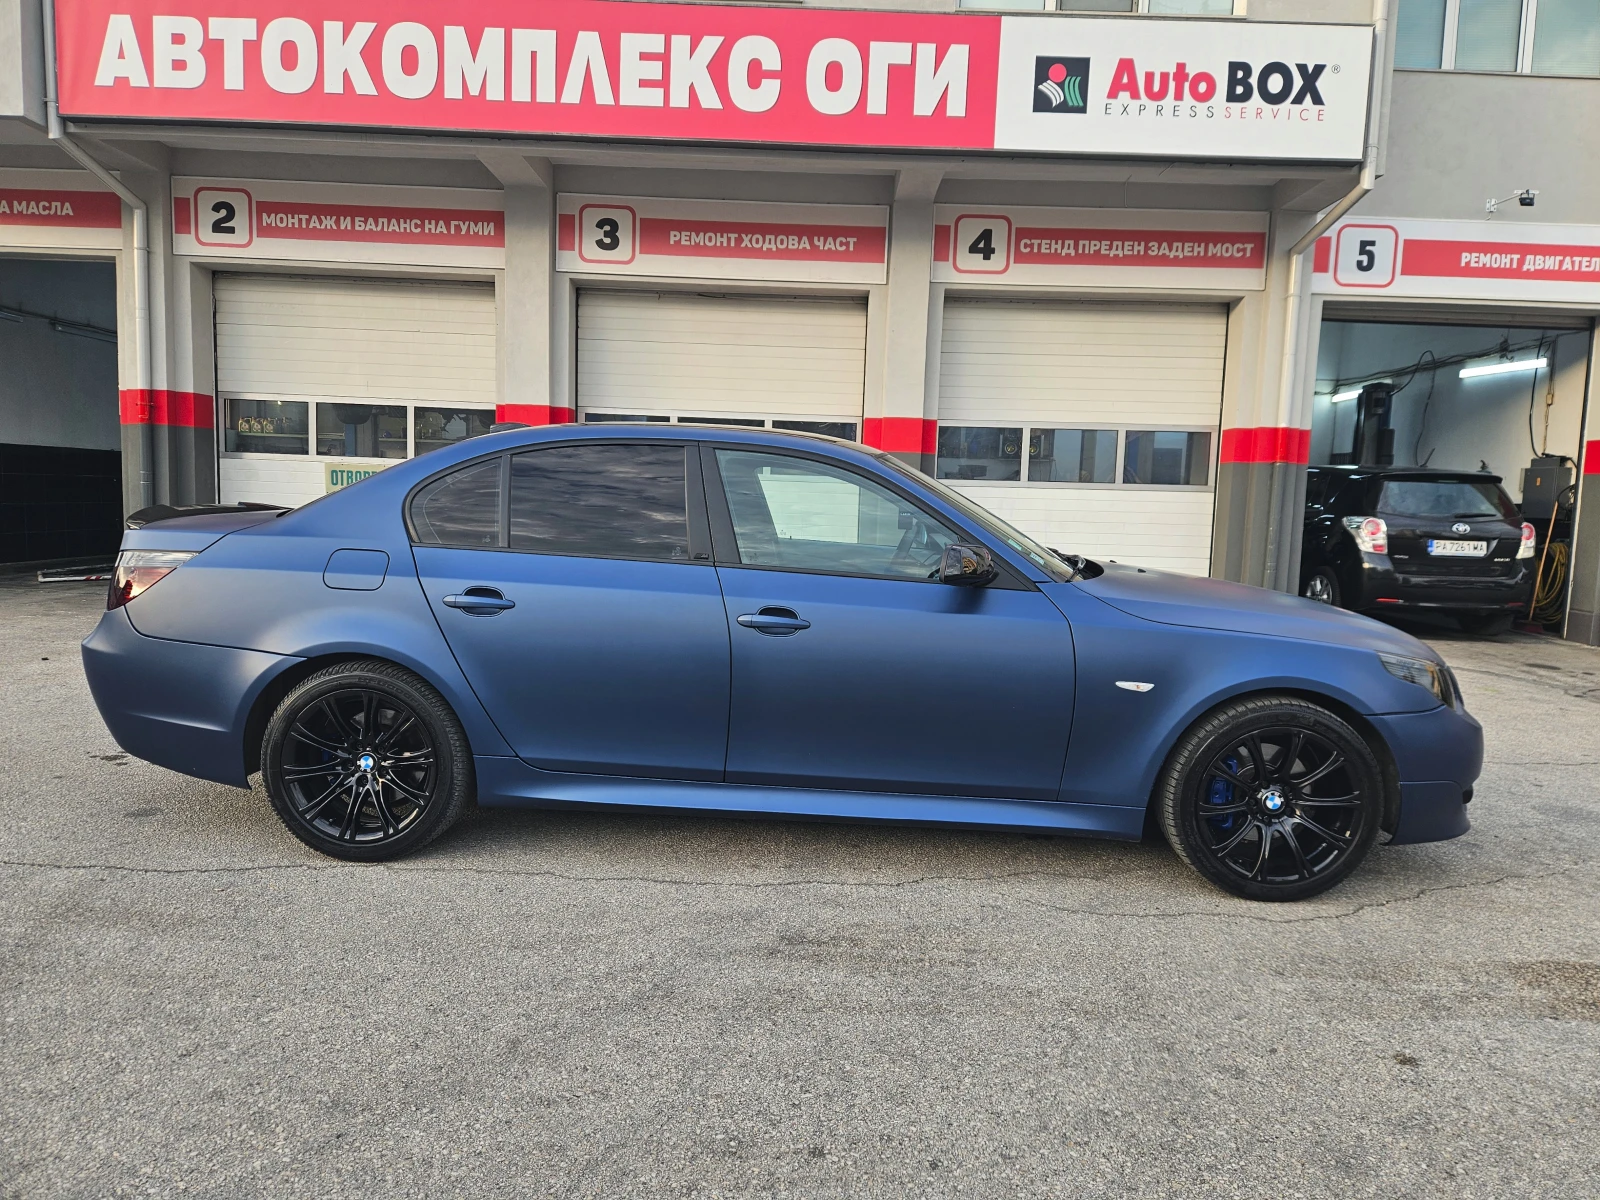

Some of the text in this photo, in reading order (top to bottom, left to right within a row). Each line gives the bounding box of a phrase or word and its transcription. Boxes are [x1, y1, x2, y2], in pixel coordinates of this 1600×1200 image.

[94, 14, 970, 117] АВТОКОМПЛЕКС ОГИ
[1106, 57, 1217, 103] Auto
[1225, 61, 1327, 106] BOX
[1104, 103, 1325, 122] EXPRESS SERVICE
[13, 200, 74, 216] МАСЛА
[211, 200, 236, 235] 2
[262, 212, 495, 236] МОНТАЖ И БАЛАНС НА ГУМИ
[595, 217, 620, 251] 3
[669, 230, 857, 252] РЕМОНТ ХОДОВА ЧАСТ
[968, 228, 996, 261] 4
[1019, 238, 1255, 258] СТЕНД ПРЕДЕН ЗАДЕН МОСТ
[1356, 240, 1377, 272] 5
[1460, 252, 1520, 269] РЕМОНТ
[1449, 541, 1471, 552] 7261
